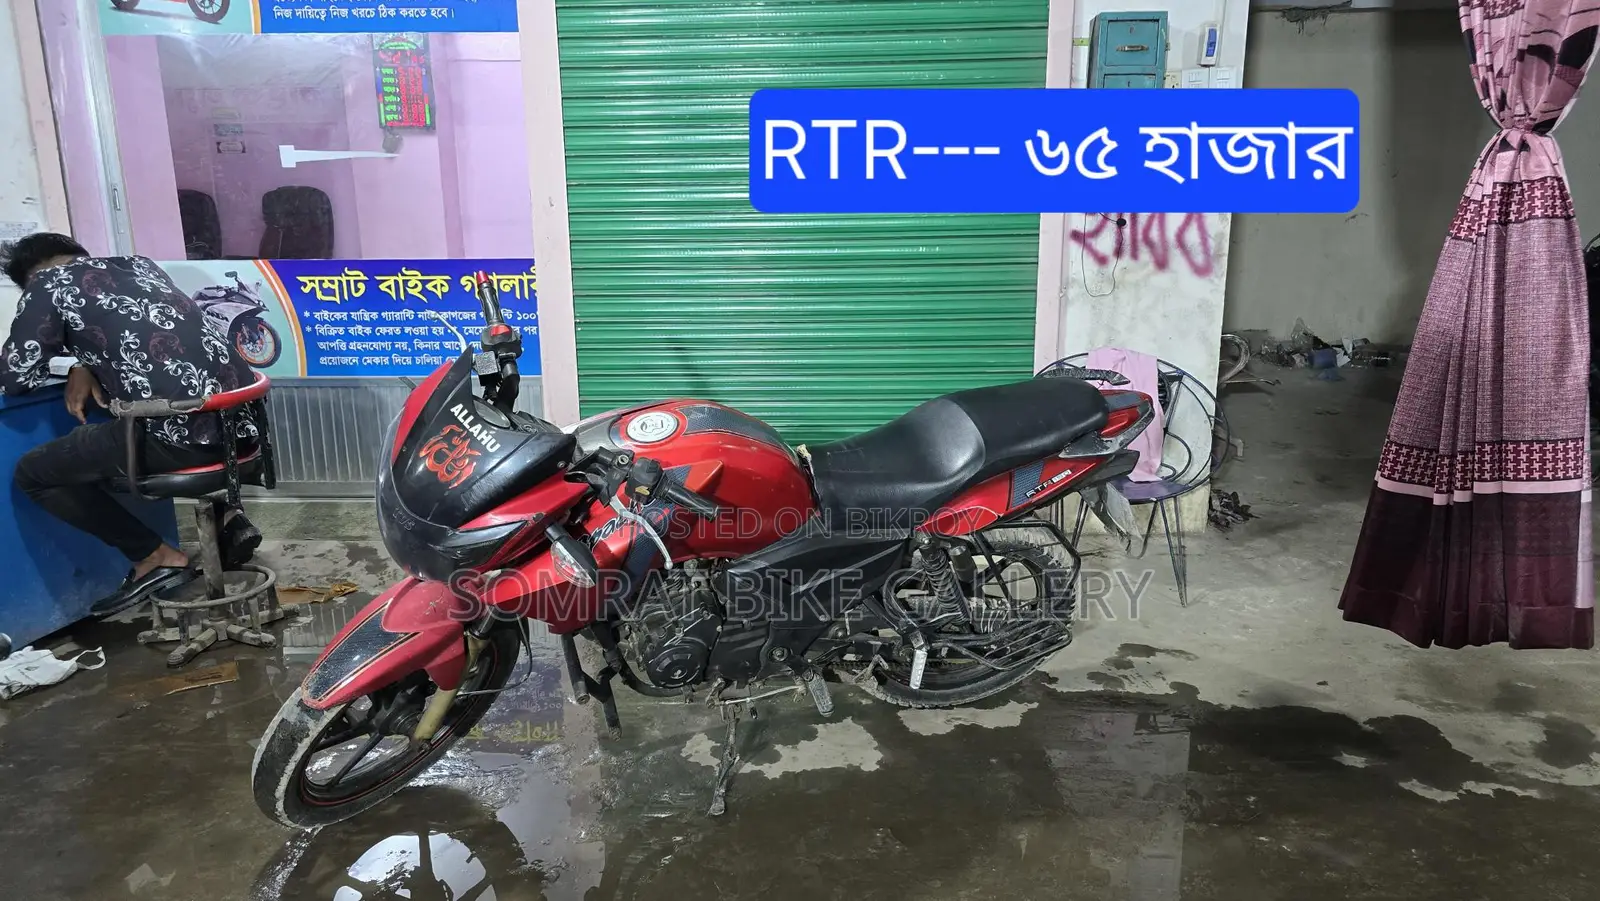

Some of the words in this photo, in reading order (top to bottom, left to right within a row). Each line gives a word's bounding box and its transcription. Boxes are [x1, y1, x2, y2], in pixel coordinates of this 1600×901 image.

[273, 5, 293, 19] নিজ
[329, 5, 349, 19] নিজ
[351, 7, 376, 18] খরচে
[378, 3, 397, 18] ঠিক
[399, 7, 428, 18] করতে
[296, 267, 369, 304] সম্রাট
[374, 267, 452, 303] বাইক
[313, 310, 348, 322] বাইকের
[517, 311, 539, 321] ১০০
[315, 323, 345, 336] বিক্রিত
[347, 324, 372, 336] বাইক
[375, 326, 402, 336] ফেরত
[403, 325, 429, 336] লওয়া
[431, 326, 445, 336] হয়
[317, 339, 346, 351] আপত্তি
[413, 338, 440, 350] কিনার
[362, 356, 390, 366] মেকার
[391, 353, 412, 366] দিয়ে
[450, 403, 501, 453] ALLAHU
